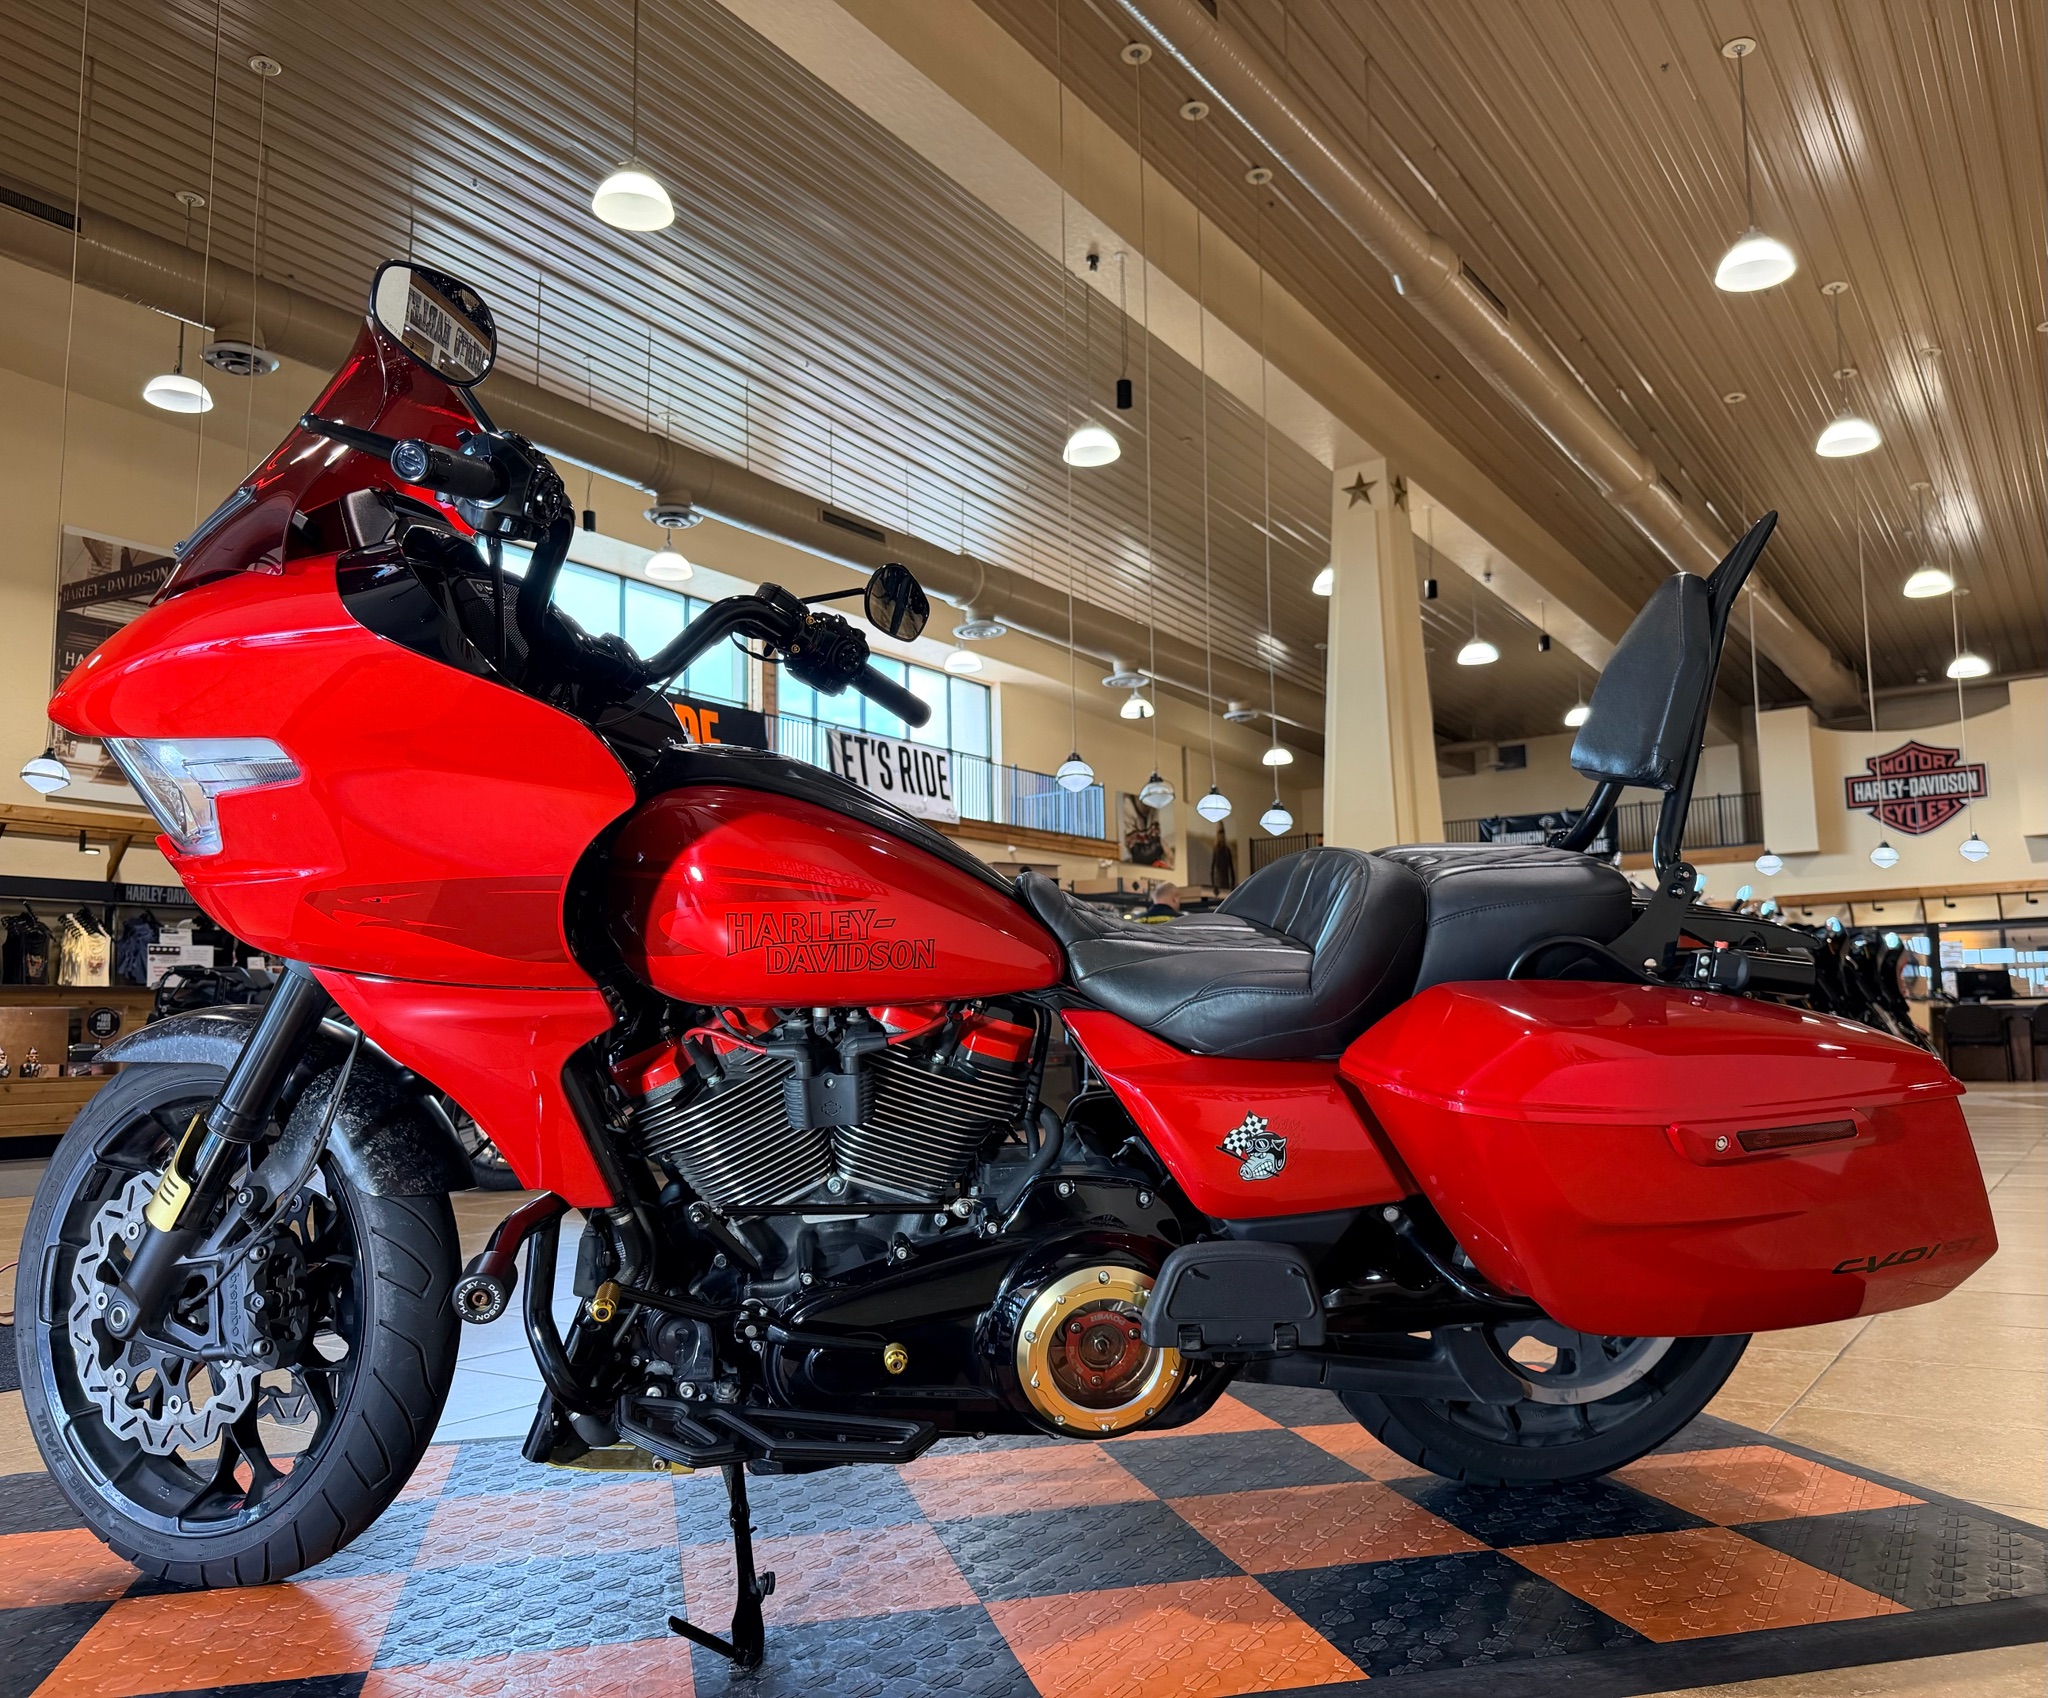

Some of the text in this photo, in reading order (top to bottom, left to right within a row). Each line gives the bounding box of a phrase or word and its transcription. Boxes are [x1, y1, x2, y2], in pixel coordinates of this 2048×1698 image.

[63, 566, 170, 602] HARLEY-DAVIDSON
[826, 732, 951, 801] LET'S RIDE
[1881, 749, 1947, 774] MOTOR
[1853, 772, 1979, 802] HARLEY-DAVIDSON
[1883, 800, 1951, 827] CYCLES
[1492, 829, 1546, 845] INTRODUCIN
[725, 908, 896, 957] HARLEY-
[766, 939, 937, 974] DAVIDSON
[229, 1272, 241, 1337] brembo
[458, 1280, 501, 1320] HARLEY DAVIDSON
[1091, 1313, 1126, 1326] POWER
[33, 1406, 108, 1521] LONG HAUL
